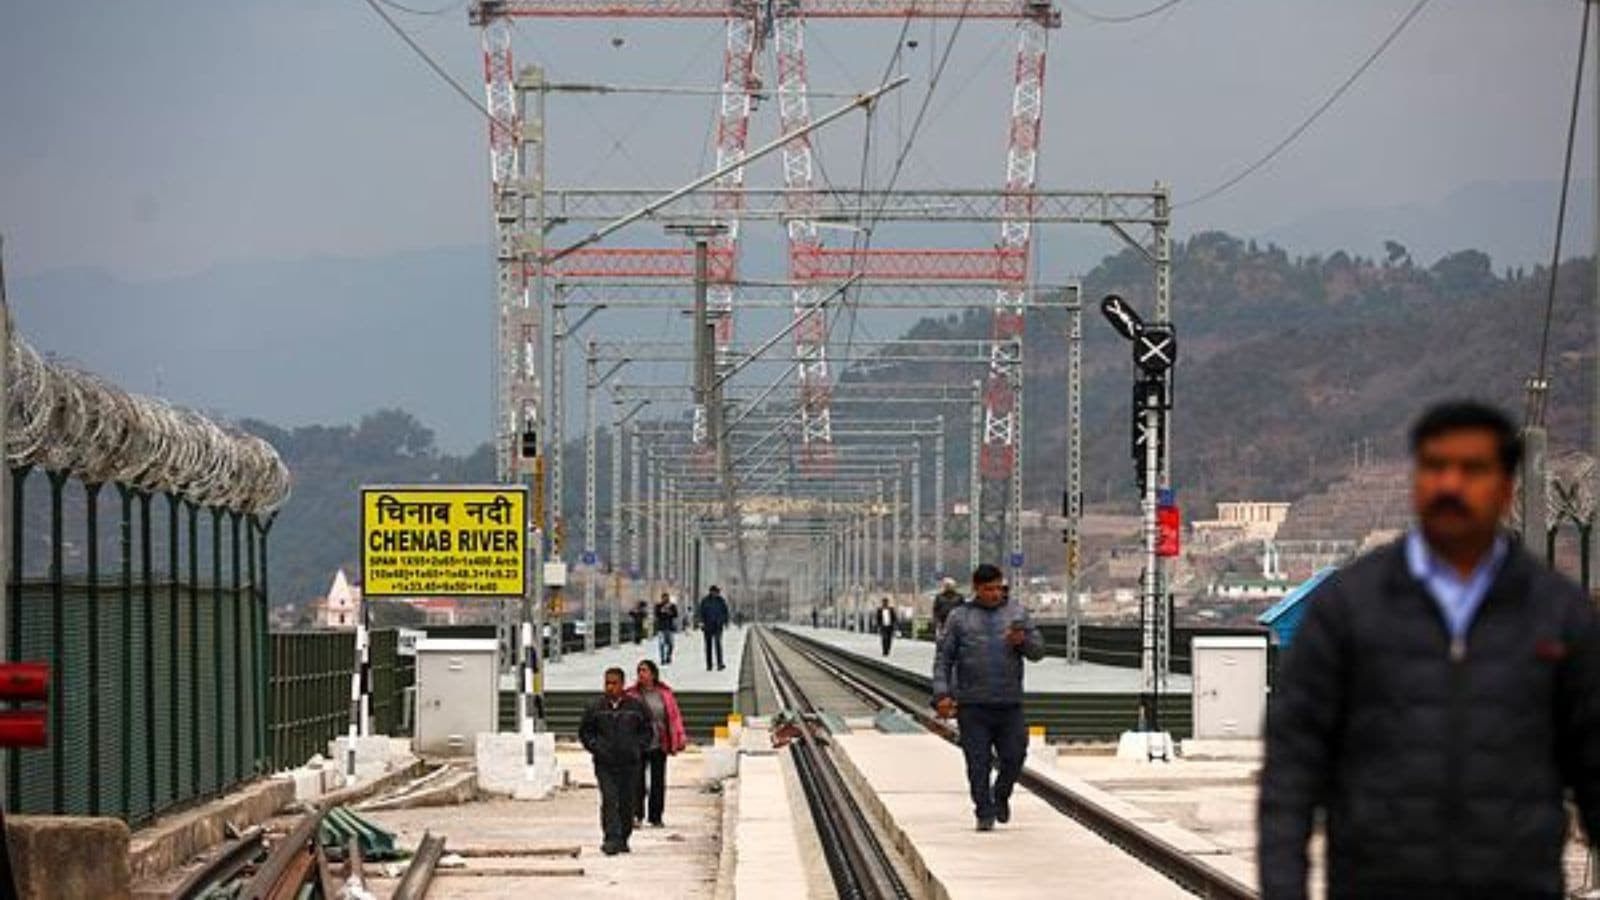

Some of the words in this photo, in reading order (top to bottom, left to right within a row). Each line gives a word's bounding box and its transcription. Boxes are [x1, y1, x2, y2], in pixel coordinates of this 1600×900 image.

[376, 494, 452, 524] चिनाब
[464, 494, 513, 524] नदी
[370, 530, 452, 552] CHENAB
[458, 530, 518, 552] RIVER
[369, 556, 397, 567] SPAN
